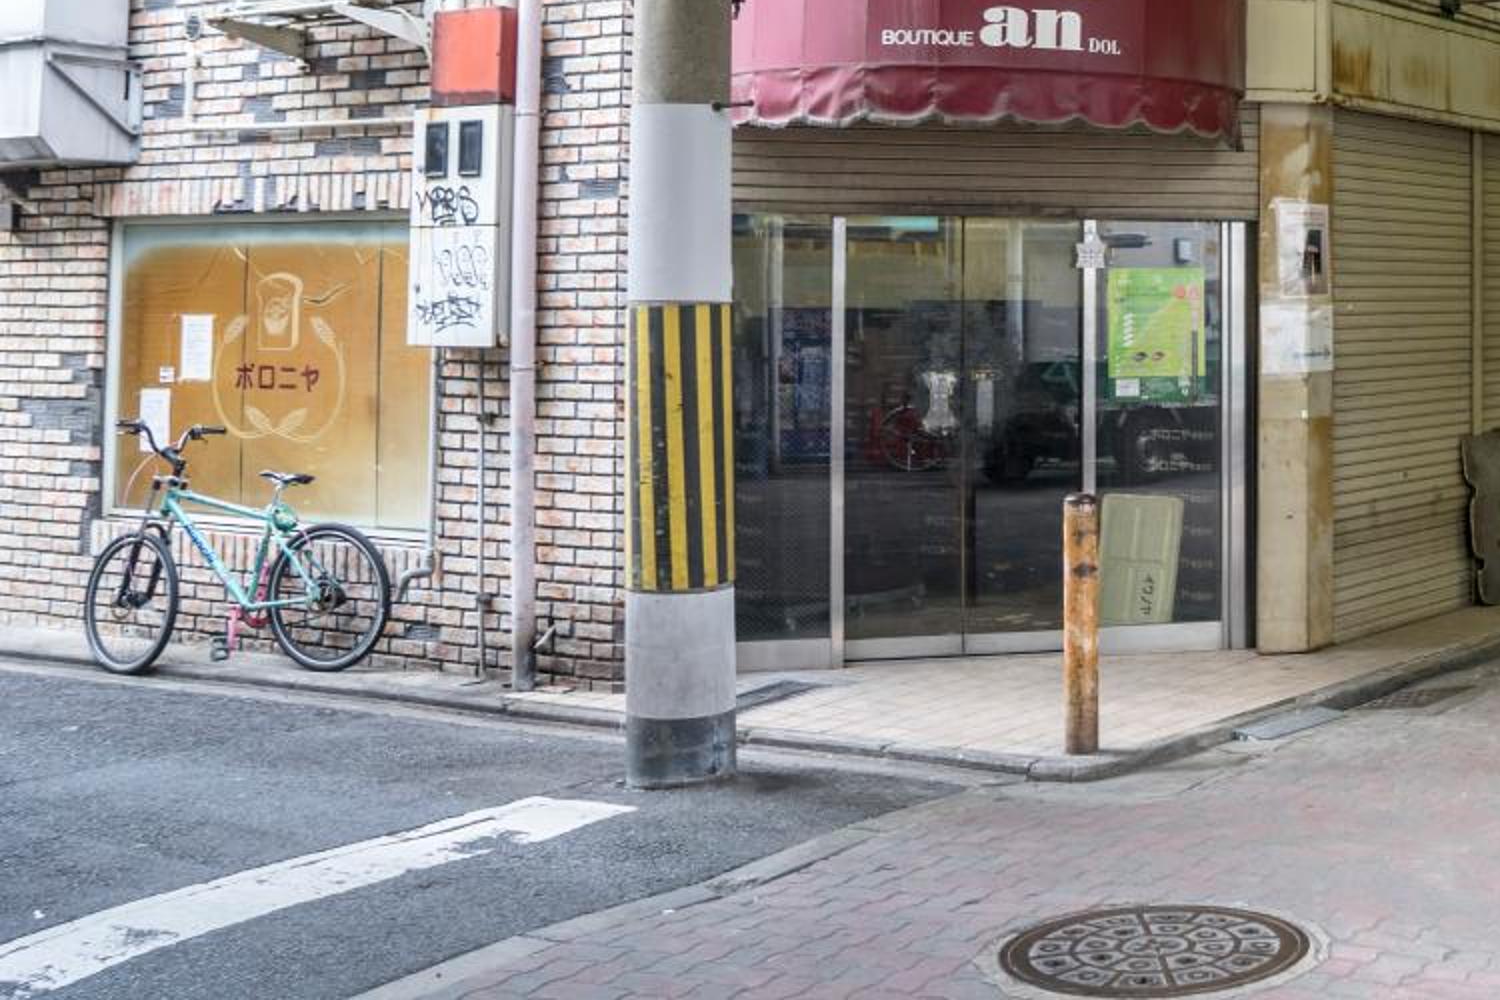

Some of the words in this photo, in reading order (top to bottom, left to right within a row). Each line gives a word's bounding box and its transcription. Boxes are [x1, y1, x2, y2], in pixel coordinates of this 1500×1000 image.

[881, 28, 975, 47] BOUTIQUE
[979, 5, 1085, 51] an
[1088, 37, 1121, 55] DOL
[235, 363, 320, 392] ボロニヤ
